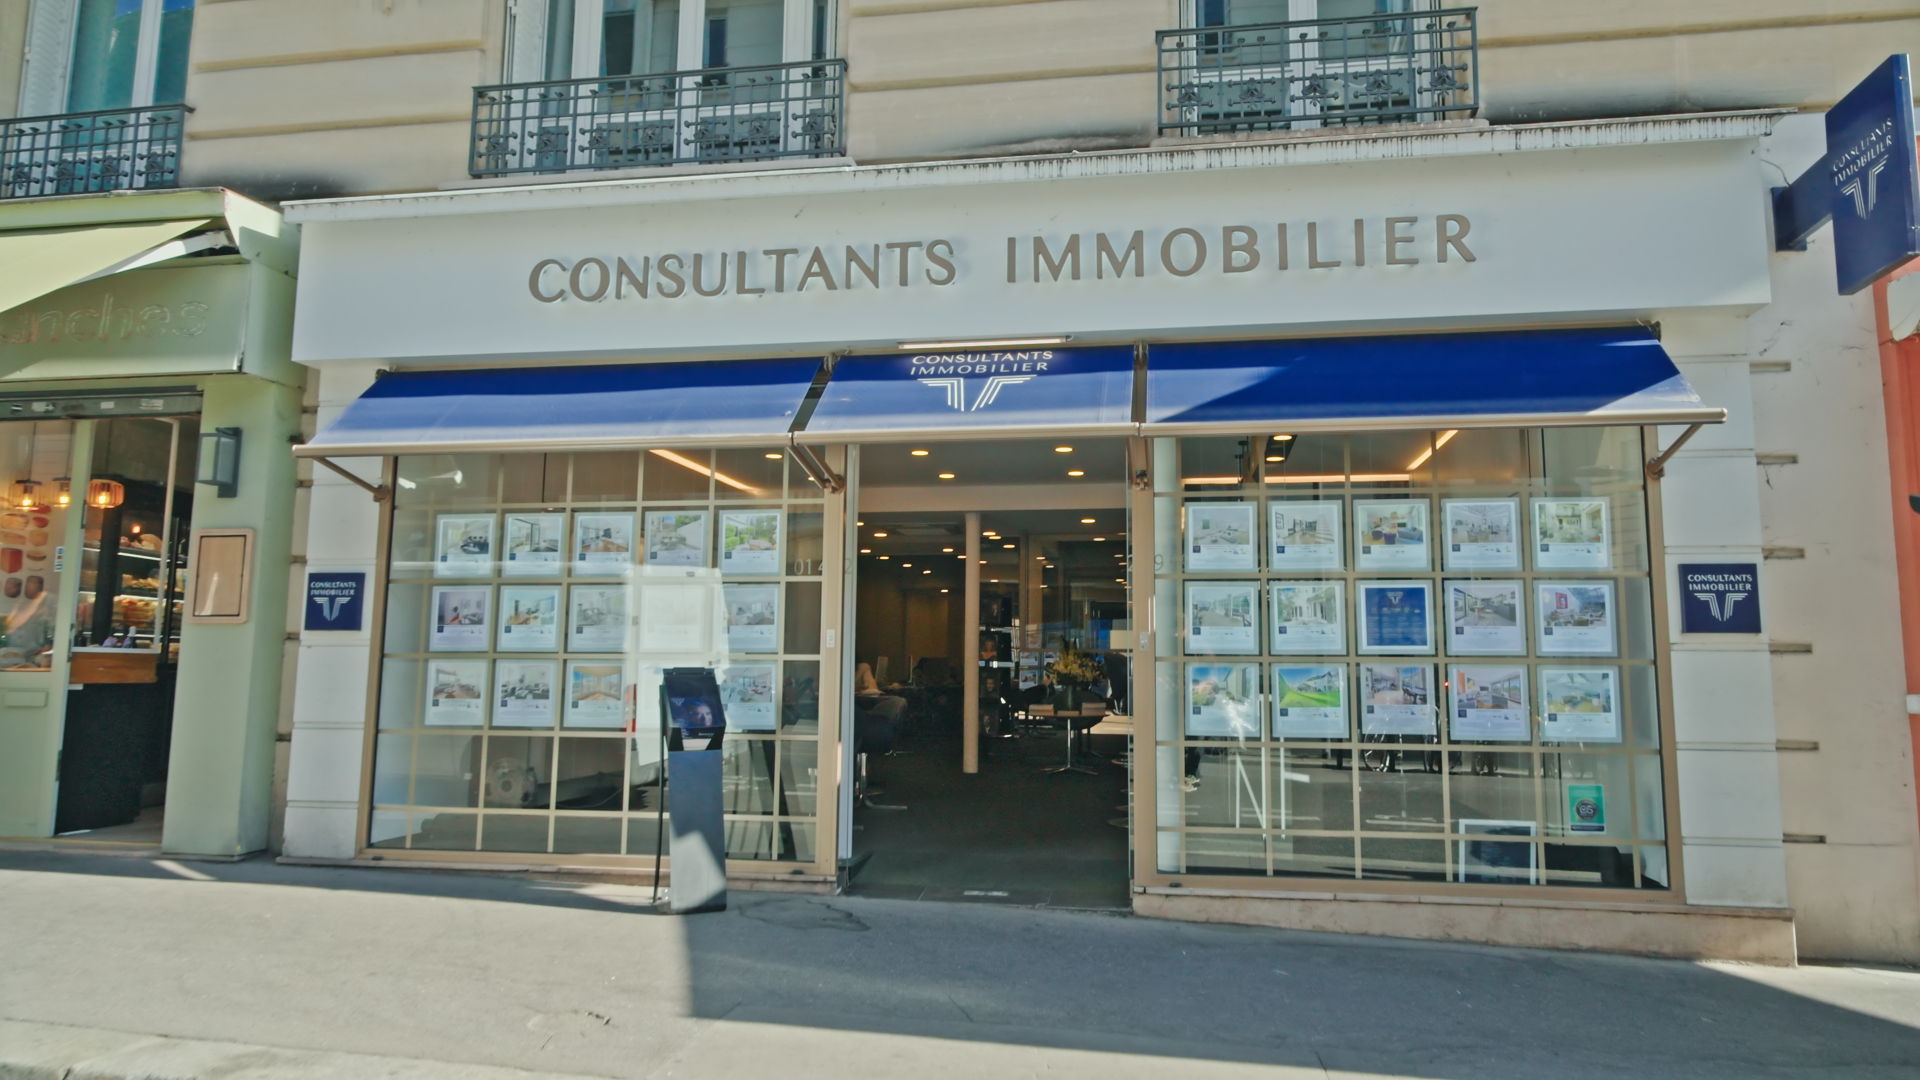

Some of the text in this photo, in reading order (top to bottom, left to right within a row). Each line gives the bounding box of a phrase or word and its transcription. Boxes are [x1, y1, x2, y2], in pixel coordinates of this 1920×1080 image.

[1833, 117, 1892, 172] CONSULTANTS
[1834, 134, 1893, 186] IMMOBILIER
[529, 213, 1478, 304] CONSULTANTS IMMOBILIER
[911, 350, 1053, 366] CONSULTANTS
[910, 361, 1049, 376] IMMOBILIER
[1687, 574, 1753, 582] CONSULTANTS
[1688, 583, 1752, 591] IMMOBILIER
